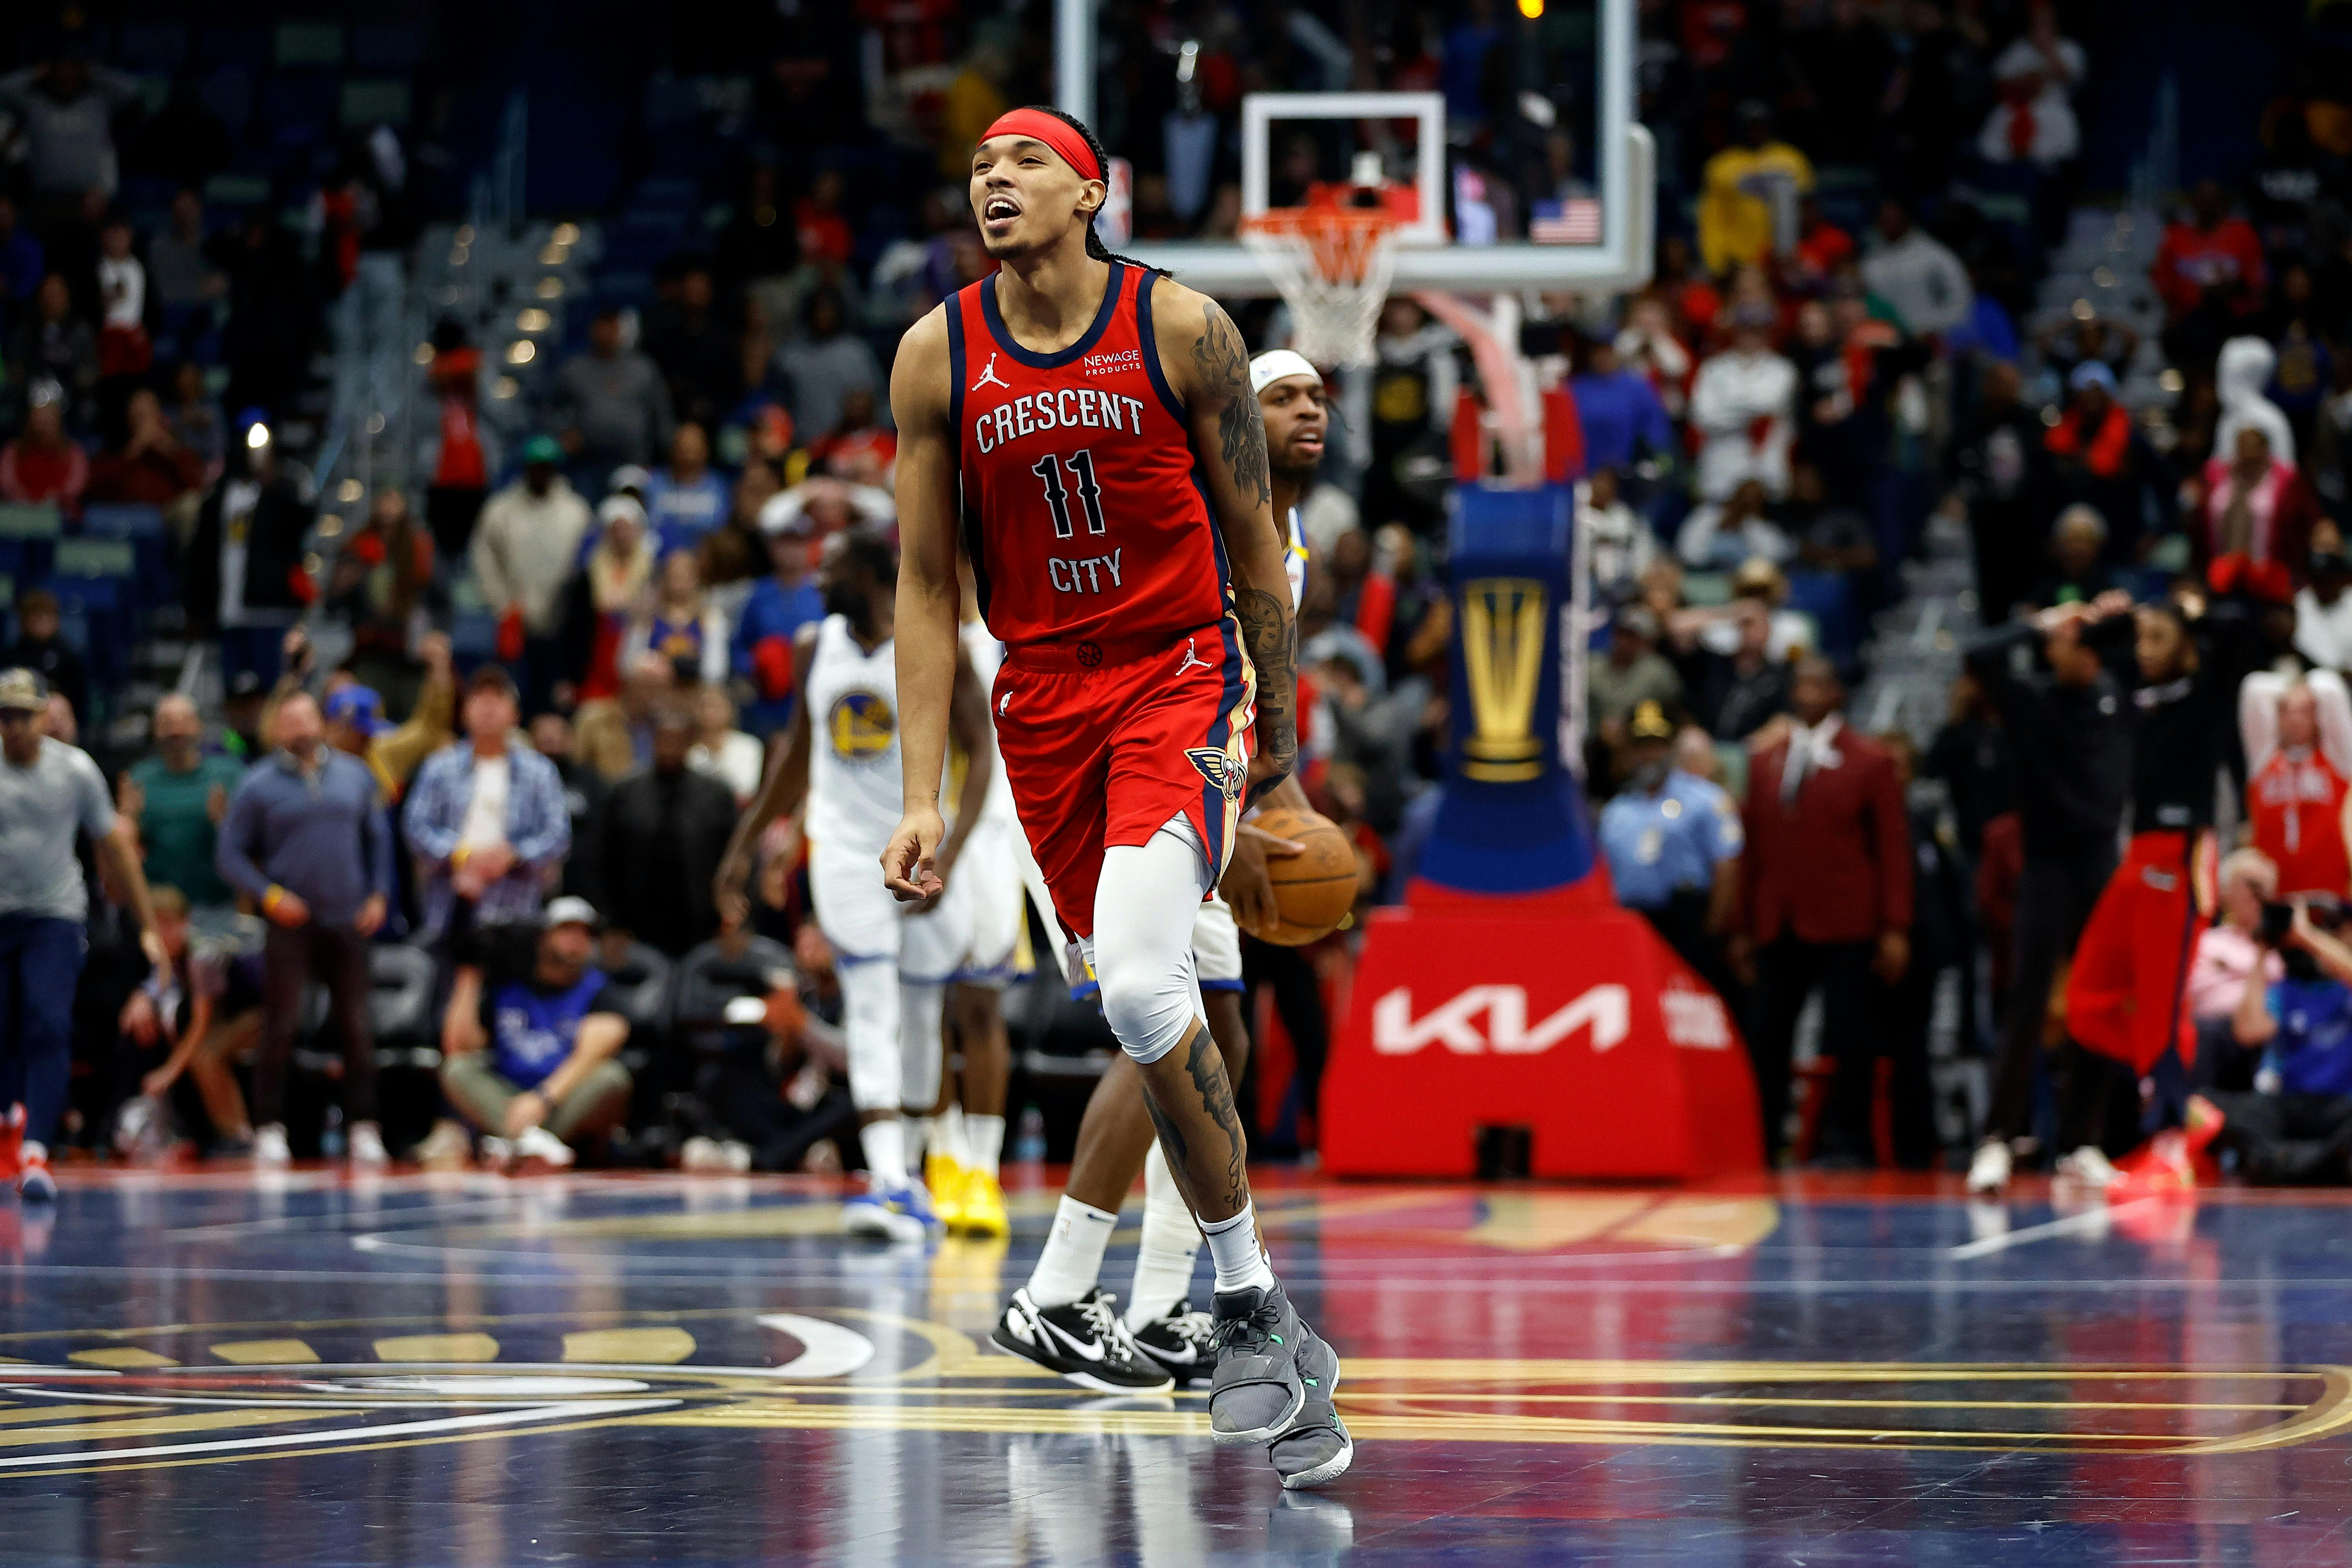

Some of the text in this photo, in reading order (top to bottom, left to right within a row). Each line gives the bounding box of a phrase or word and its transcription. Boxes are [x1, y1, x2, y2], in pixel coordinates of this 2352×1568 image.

[1084, 350, 1140, 367] NEWAGE
[1085, 363, 1141, 377] PRODUCTS
[975, 388, 1144, 454] CRESCENT
[1031, 449, 1105, 538] 11
[1049, 547, 1122, 593] CITY
[1372, 983, 1631, 1056] KIA
